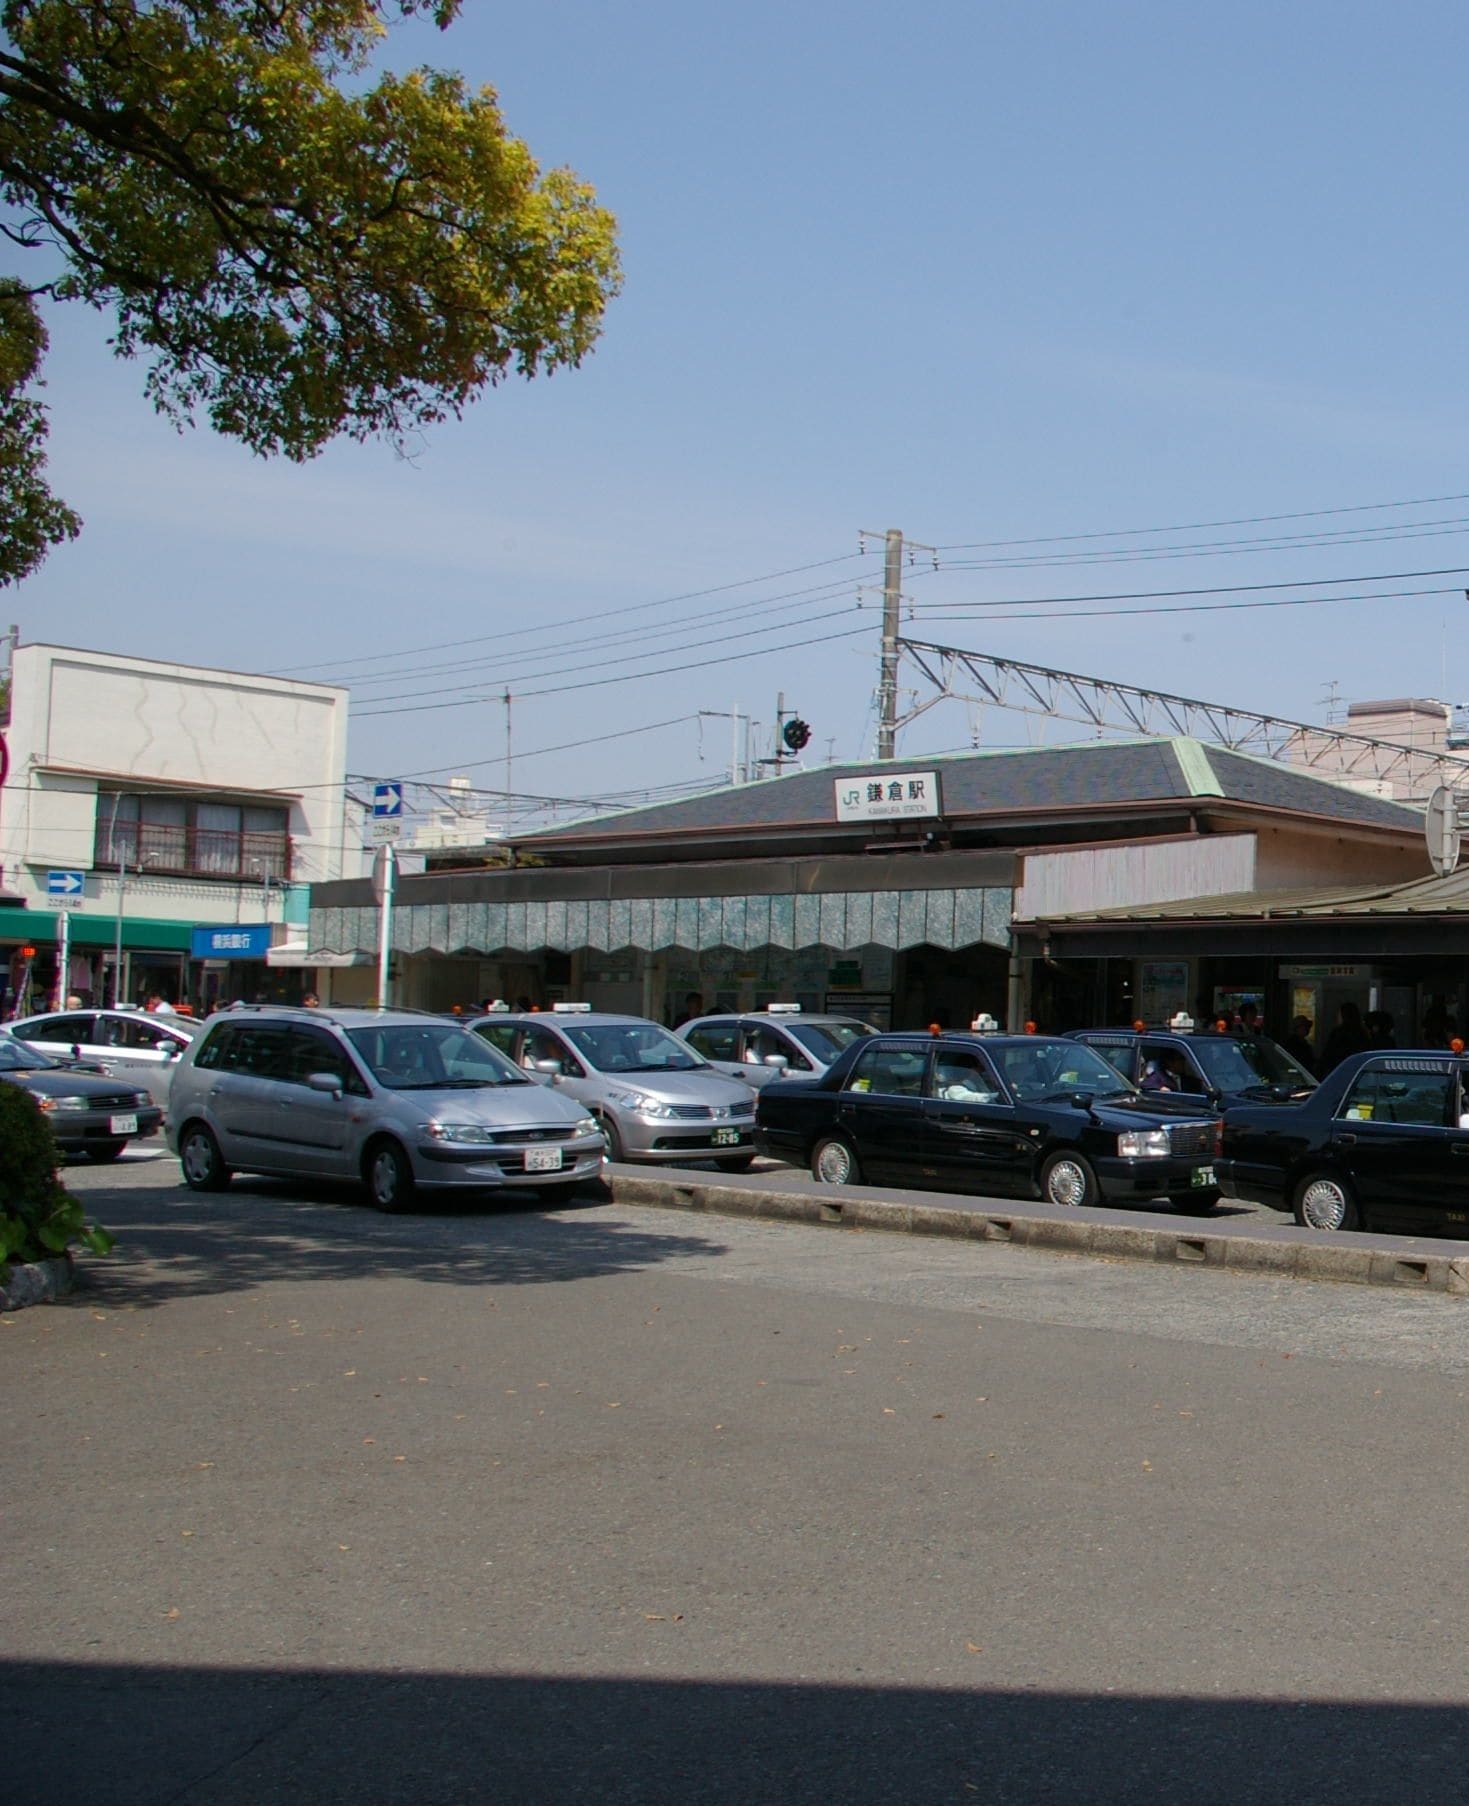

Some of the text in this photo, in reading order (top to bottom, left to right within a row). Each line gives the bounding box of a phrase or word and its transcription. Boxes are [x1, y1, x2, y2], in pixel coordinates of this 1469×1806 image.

[843, 790, 860, 806] JR
[867, 780, 925, 803] 鎌倉駅
[212, 932, 251, 949] 横浜銀行
